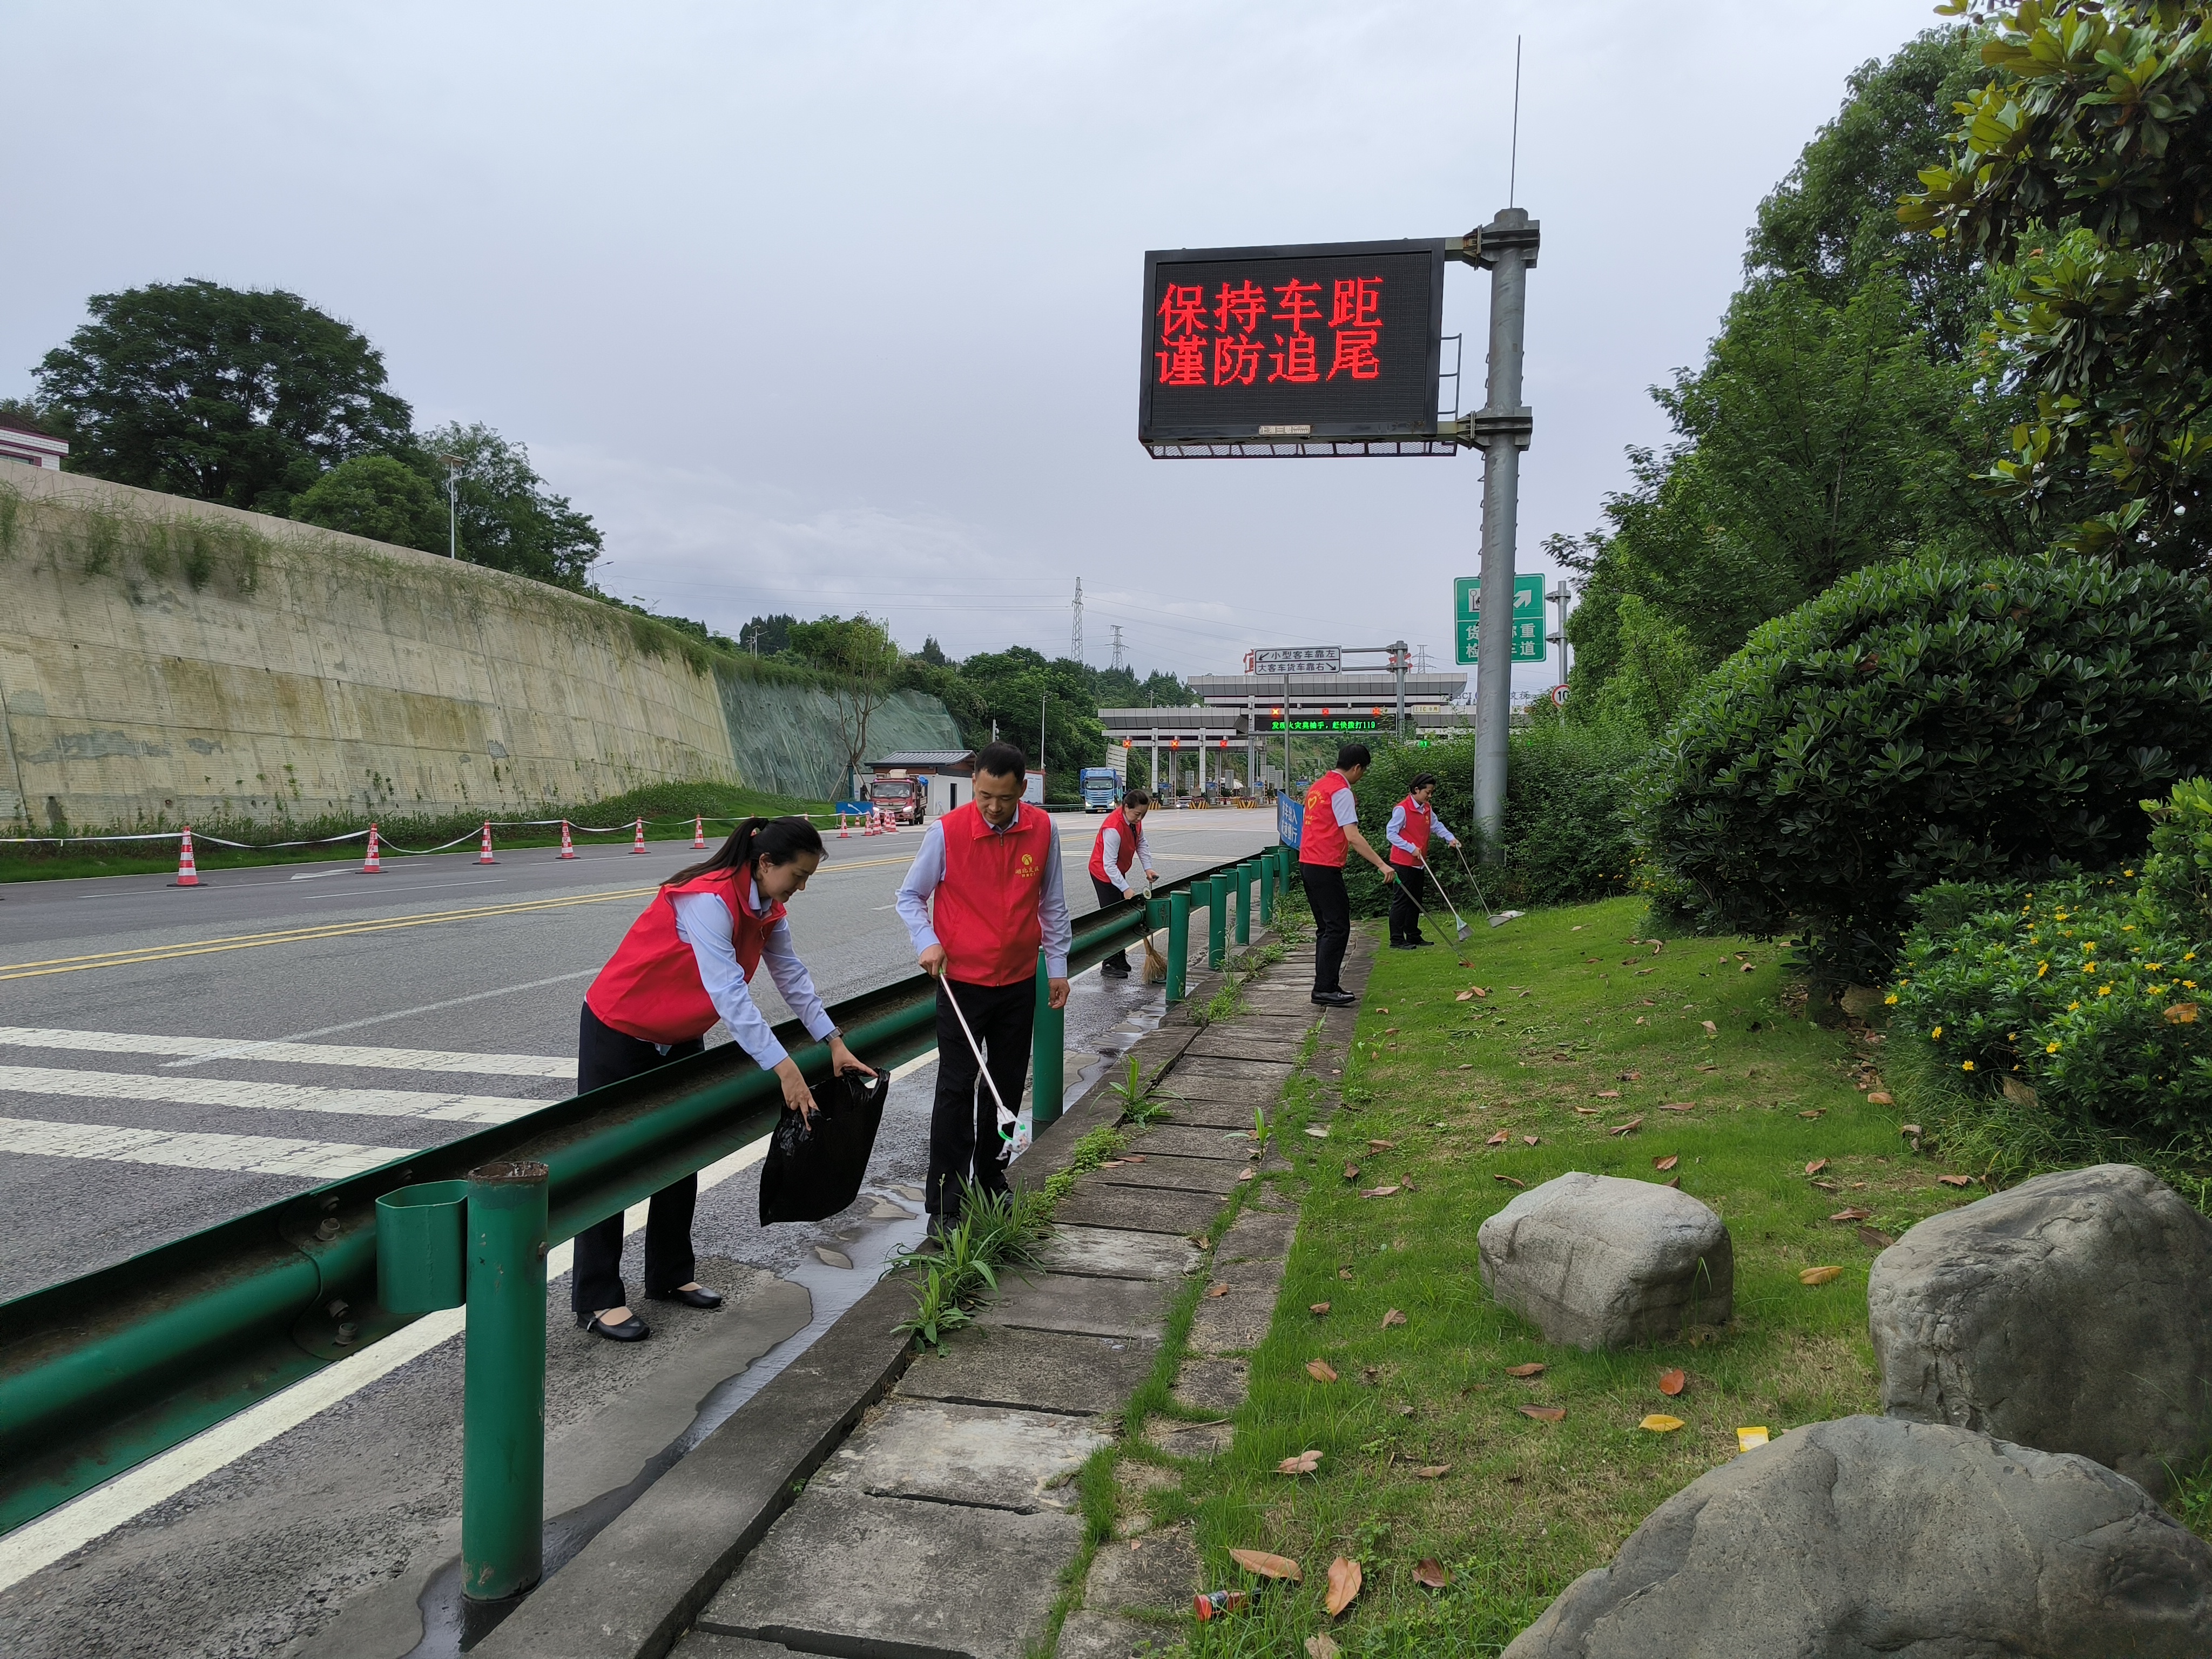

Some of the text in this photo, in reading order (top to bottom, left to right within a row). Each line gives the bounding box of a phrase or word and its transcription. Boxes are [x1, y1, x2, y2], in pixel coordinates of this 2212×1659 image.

[1157, 276, 1383, 335] 保持车距
[1155, 329, 1380, 385] 谨防追尾
[1257, 662, 1325, 672] 大客车货车靠右
[1271, 649, 1336, 660] 小型客车靠左
